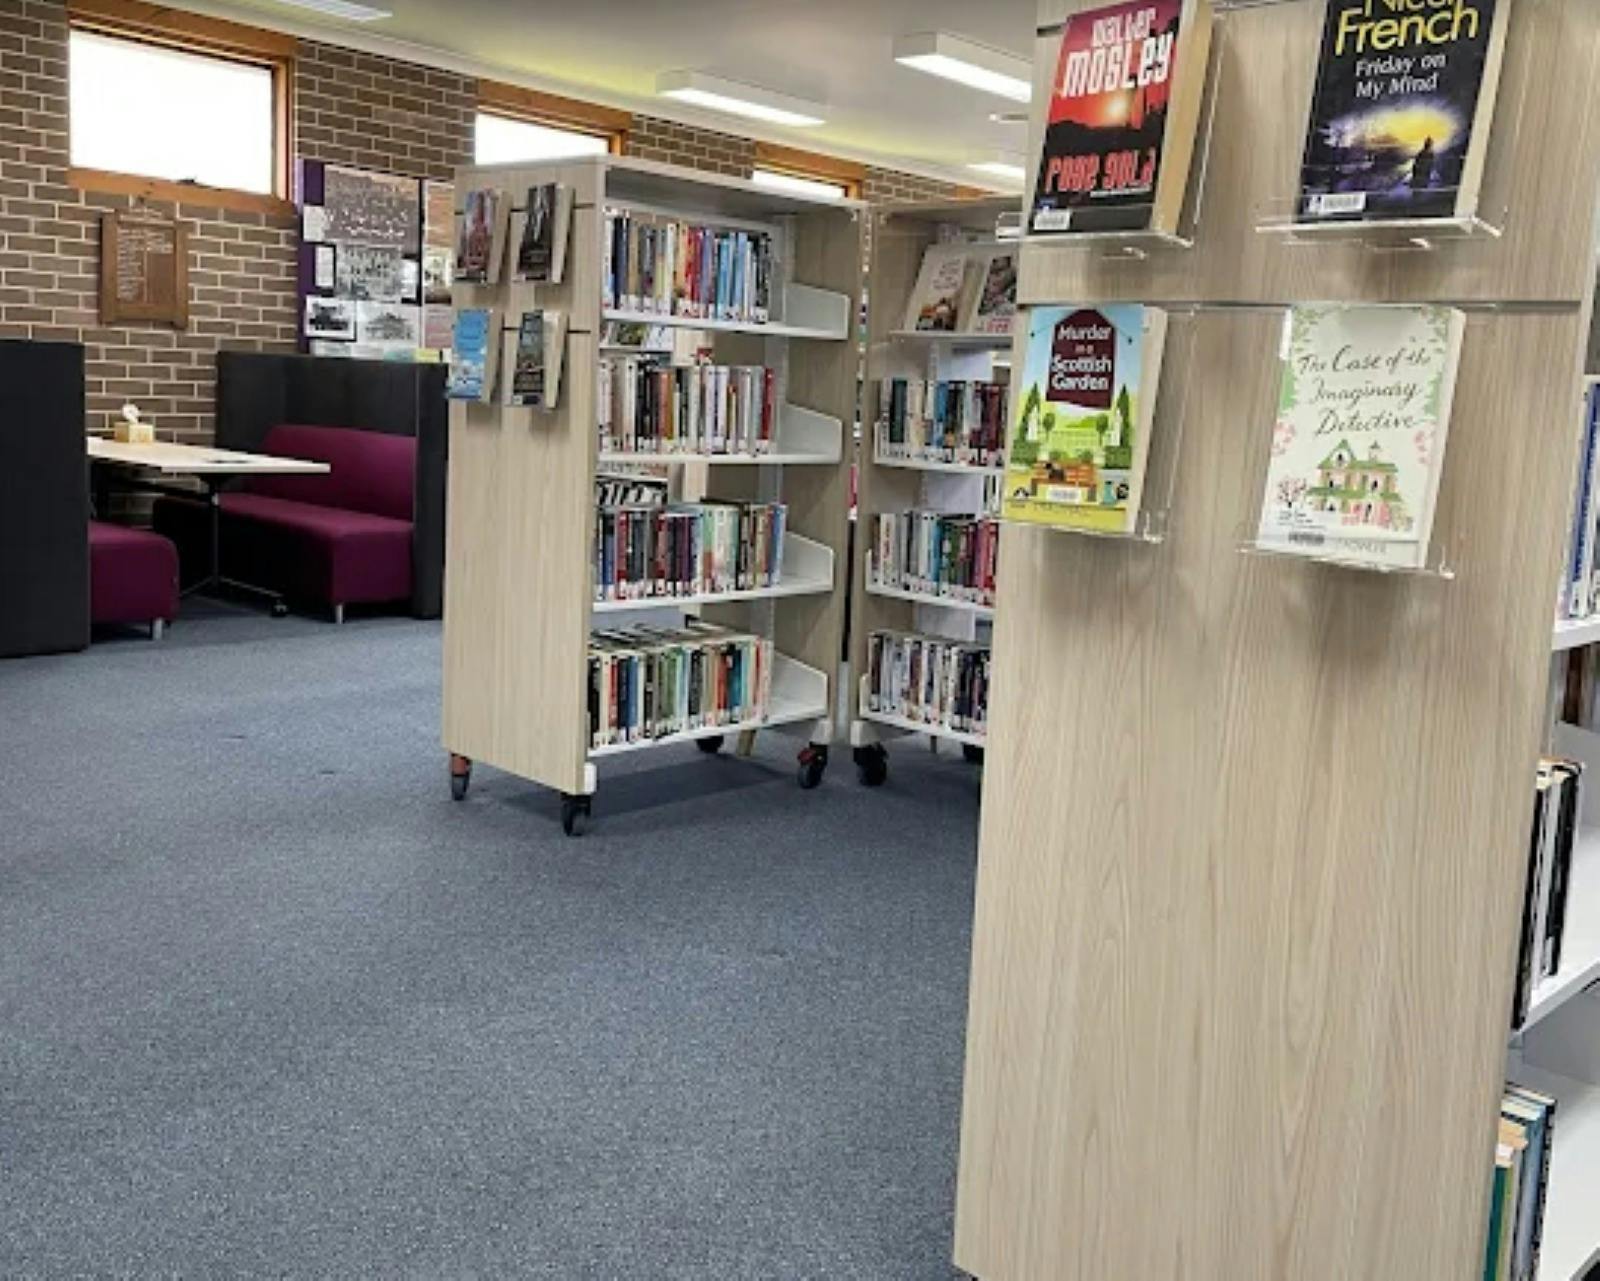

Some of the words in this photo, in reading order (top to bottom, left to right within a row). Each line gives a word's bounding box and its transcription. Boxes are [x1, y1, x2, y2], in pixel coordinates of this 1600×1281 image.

[1335, 1, 1479, 56] French
[1355, 55, 1414, 78] Friday
[1421, 54, 1446, 69] on
[1355, 81, 1384, 101] My
[1388, 72, 1438, 95] Mind
[1057, 324, 1112, 340] Murder
[1049, 353, 1113, 373] Scottish
[1298, 354, 1327, 374] The
[1332, 345, 1381, 372] Case
[1385, 347, 1407, 374] of
[1051, 372, 1109, 391] Garden
[1310, 376, 1420, 409] Imaginary
[1315, 407, 1415, 437] Detective
